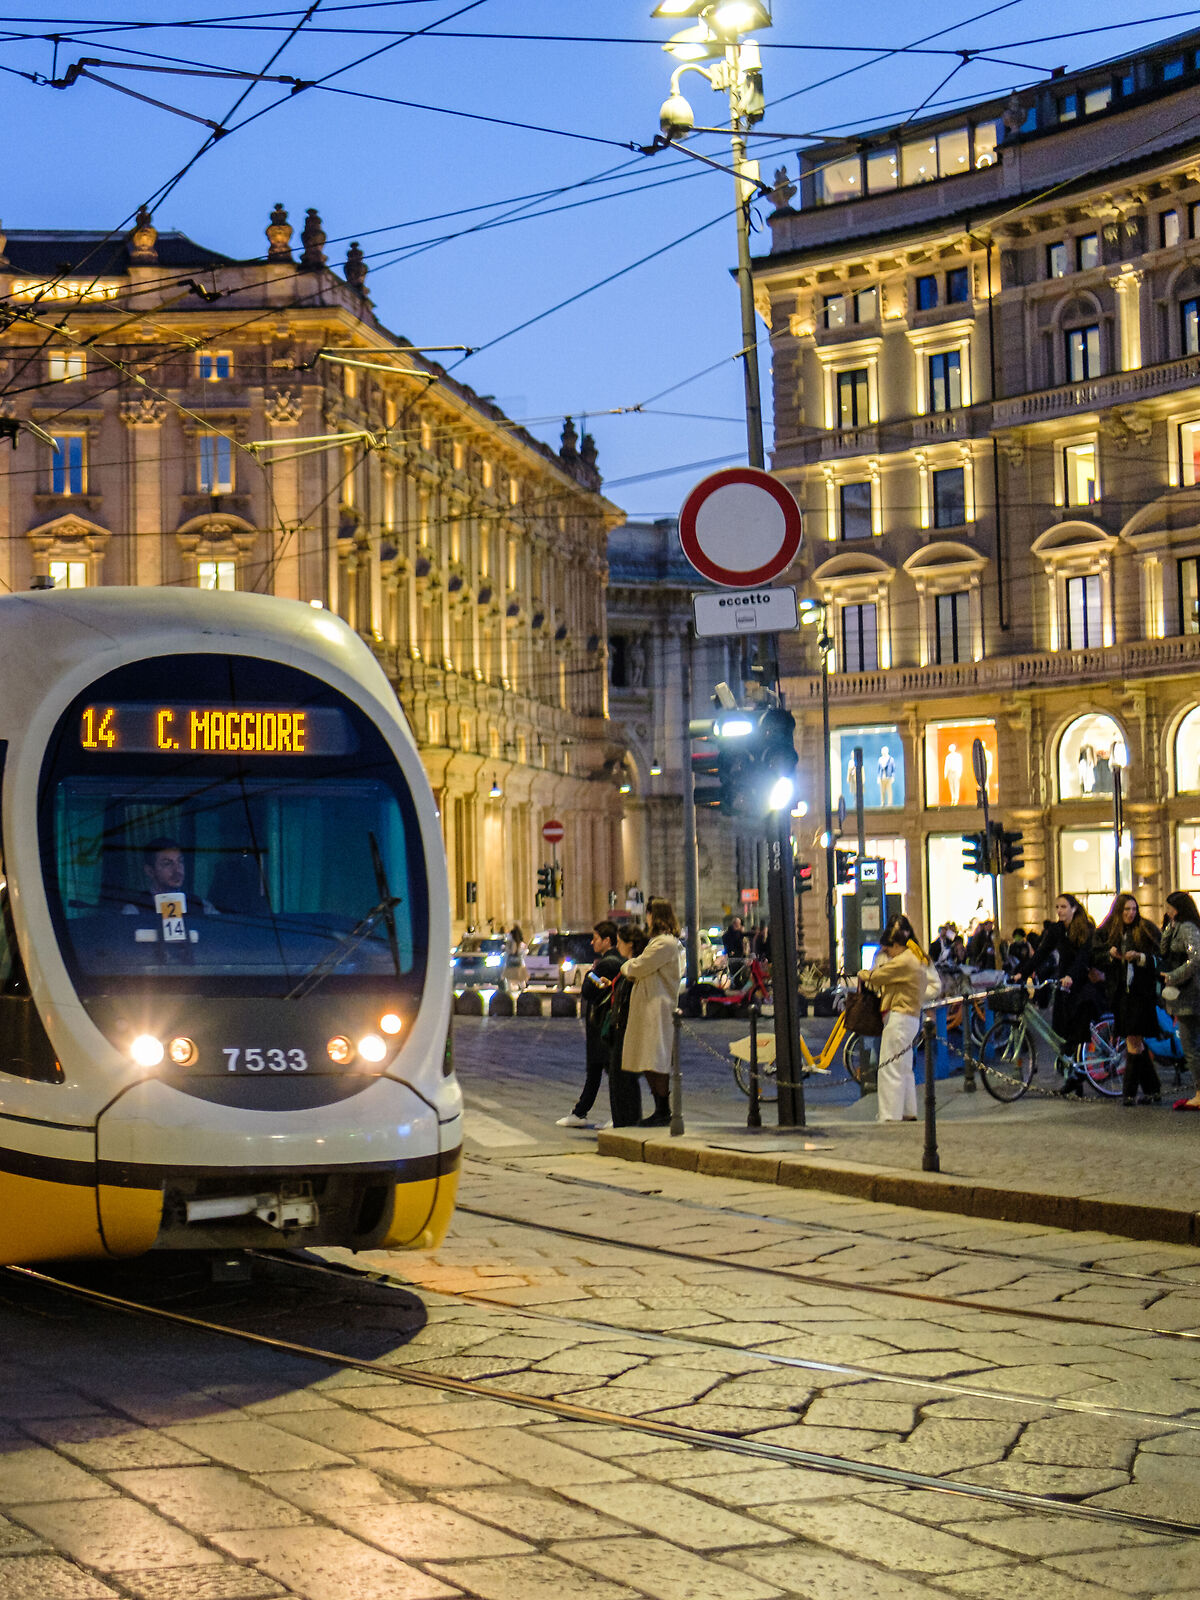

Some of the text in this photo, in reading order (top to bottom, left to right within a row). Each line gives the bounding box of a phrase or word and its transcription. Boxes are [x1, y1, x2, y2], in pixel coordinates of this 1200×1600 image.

[719, 593, 770, 606] eccetto
[82, 709, 305, 752] 14 C. MAGGIORE
[167, 903, 176, 918] 2
[165, 921, 183, 936] 14
[222, 1048, 308, 1072] 7533
